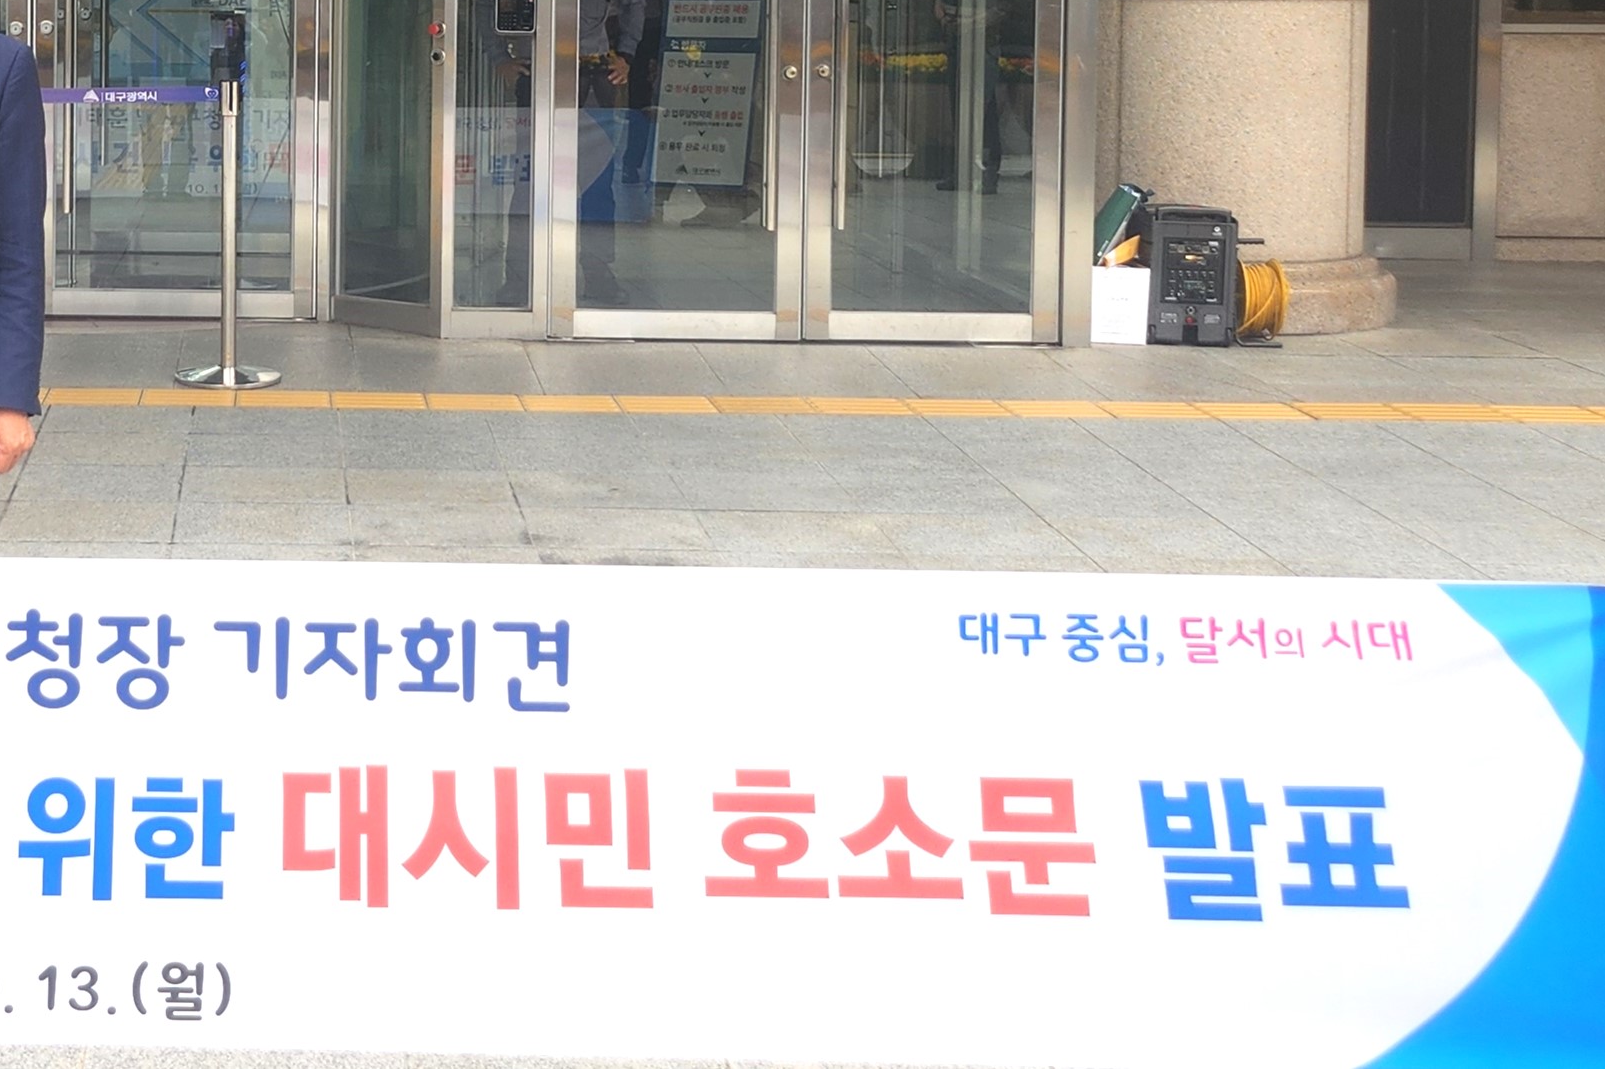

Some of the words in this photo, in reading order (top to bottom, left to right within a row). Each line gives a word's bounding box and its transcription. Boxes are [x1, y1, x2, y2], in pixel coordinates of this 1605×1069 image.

[104, 90, 158, 103] 대구광역시
[213, 616, 571, 712] 기자회견
[957, 612, 1047, 657] 대구
[1061, 613, 1166, 667] 중심,
[1179, 615, 1305, 665] 달서의
[1321, 618, 1414, 663] 시대
[18, 776, 235, 900] 위한
[276, 764, 654, 910] 대시민
[704, 768, 1097, 918] 호소문
[1138, 776, 1411, 922] 발표
[37, 960, 233, 1021] 13.(월)
